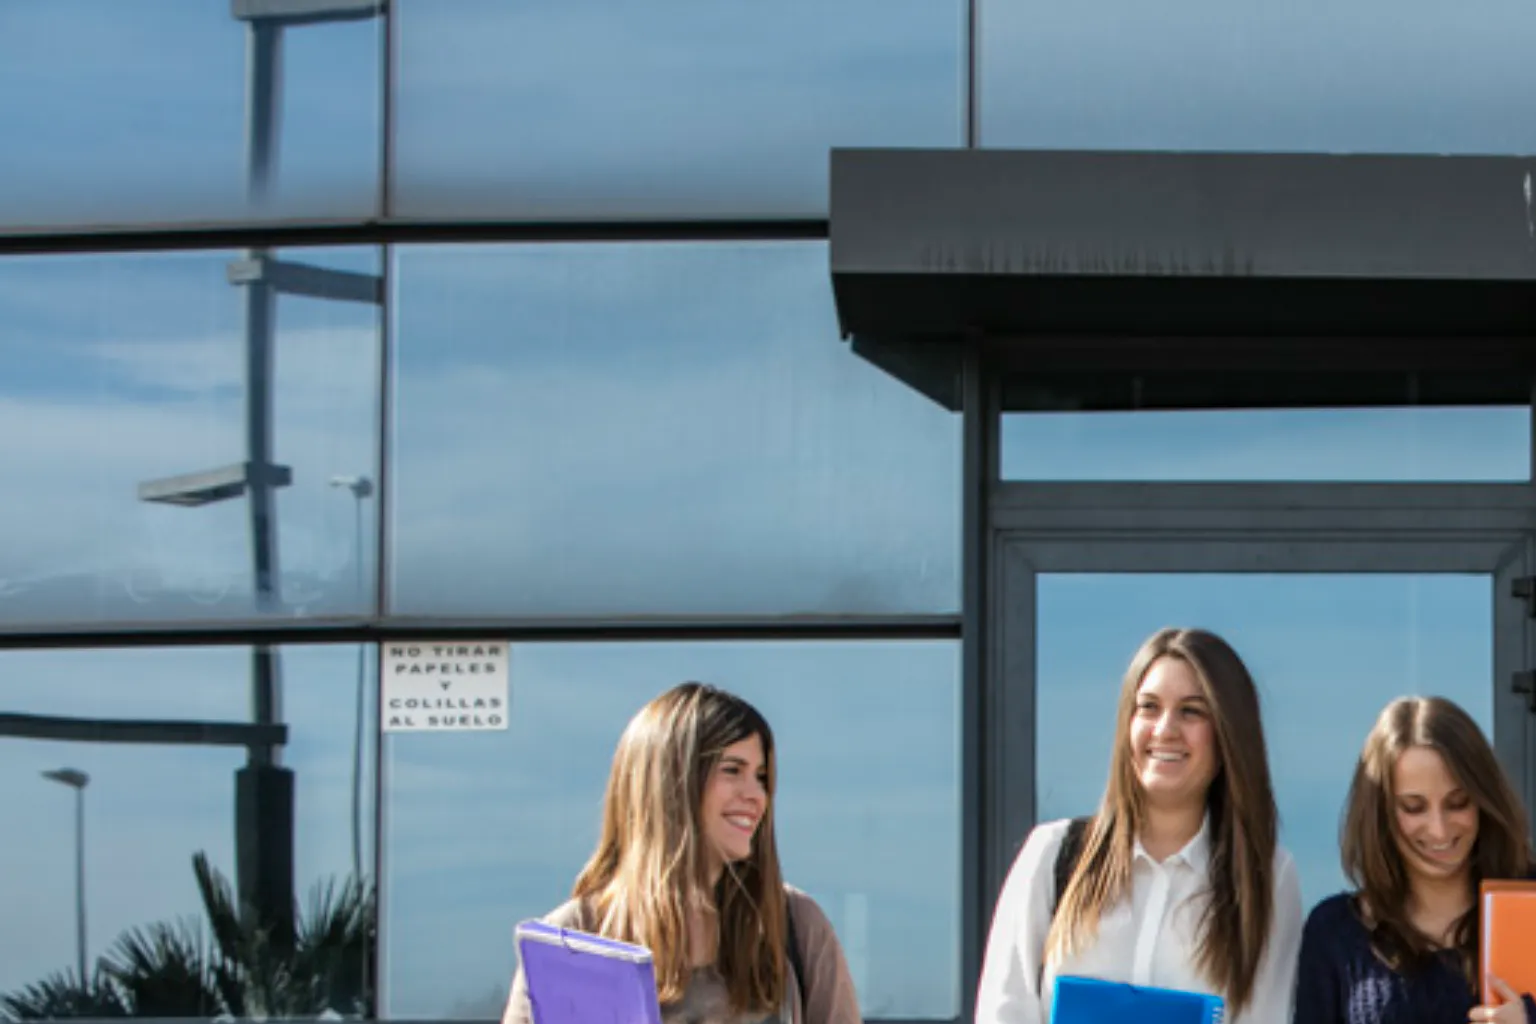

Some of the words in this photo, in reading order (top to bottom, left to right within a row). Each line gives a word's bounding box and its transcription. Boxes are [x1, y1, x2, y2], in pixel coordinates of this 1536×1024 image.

[390, 646, 421, 658] NO
[432, 645, 501, 658] TIRAR
[394, 663, 497, 675] PAPELES
[440, 680, 452, 691] Y
[389, 698, 502, 709] COLILLAS
[389, 715, 415, 727] AL
[428, 714, 503, 727] SUELO
